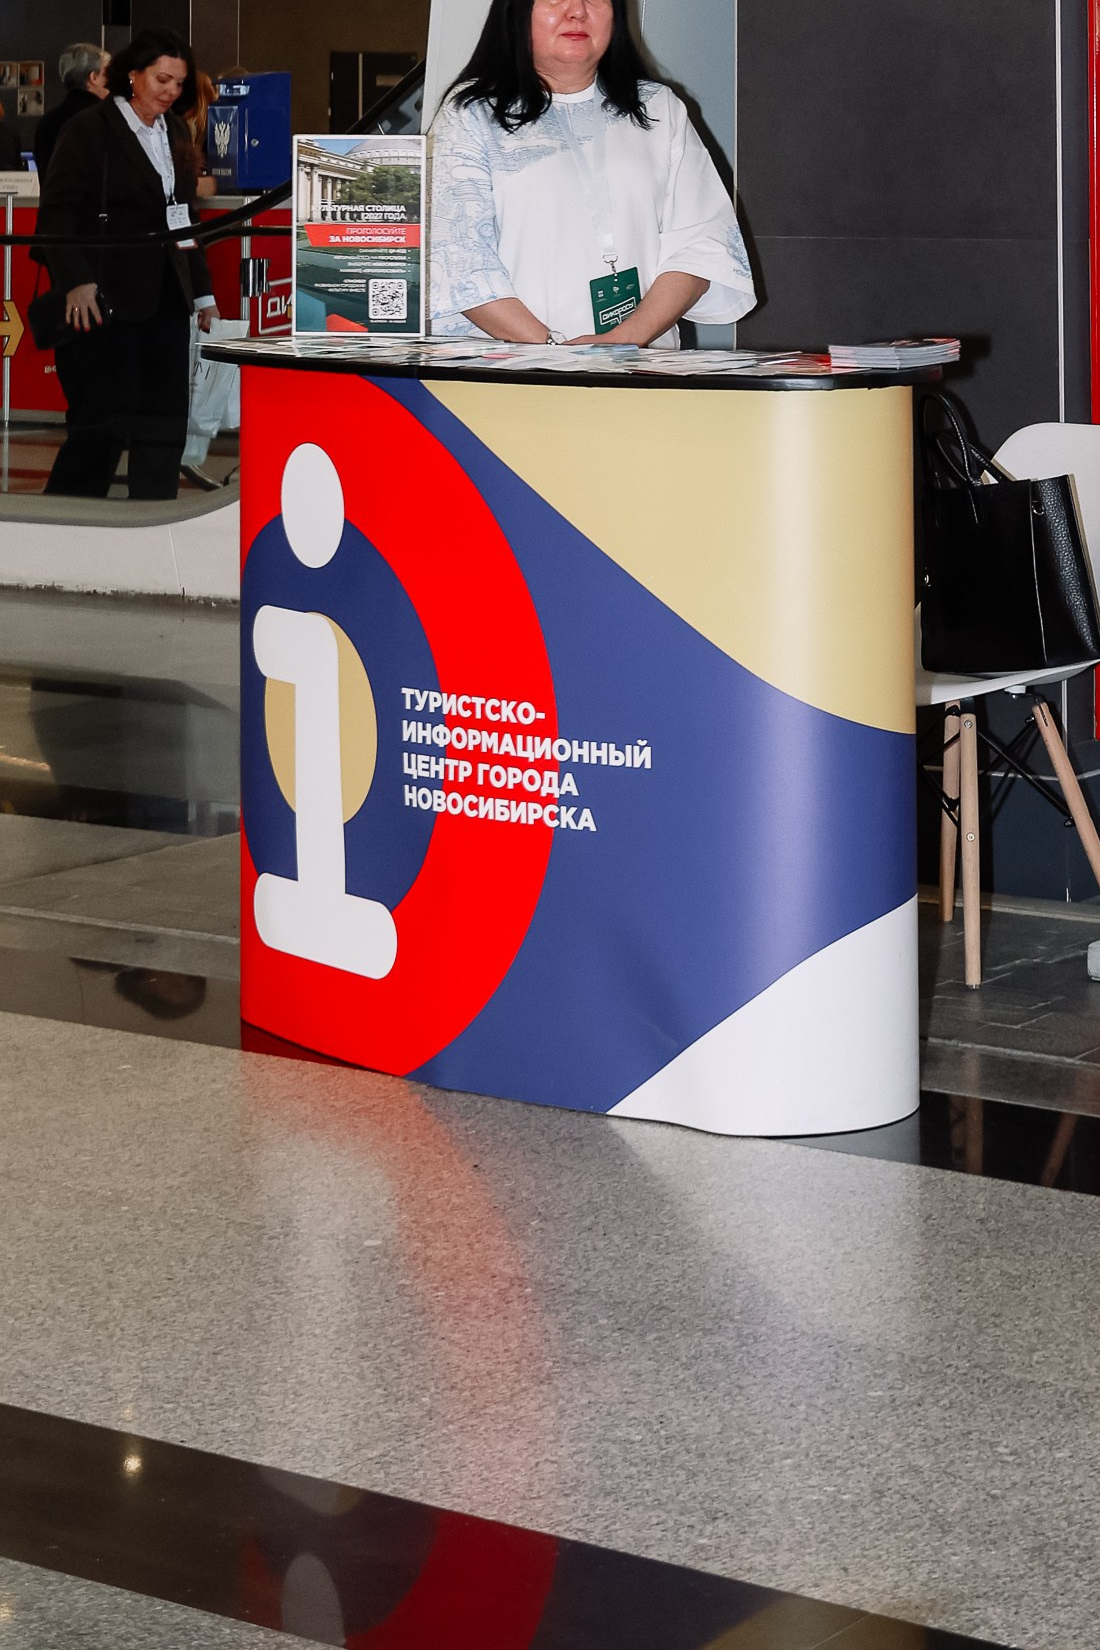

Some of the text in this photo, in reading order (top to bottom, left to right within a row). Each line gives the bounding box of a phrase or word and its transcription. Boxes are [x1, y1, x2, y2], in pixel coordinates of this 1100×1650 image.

[329, 235, 341, 243] ЗА
[401, 687, 546, 725] ТУРИСТСКО-
[402, 720, 652, 770] ИНФОРМАЦИОННЫЙ
[402, 751, 580, 799] ЦЕНТР ГОРОДА
[404, 784, 597, 832] НОВОСИБИРСКА
